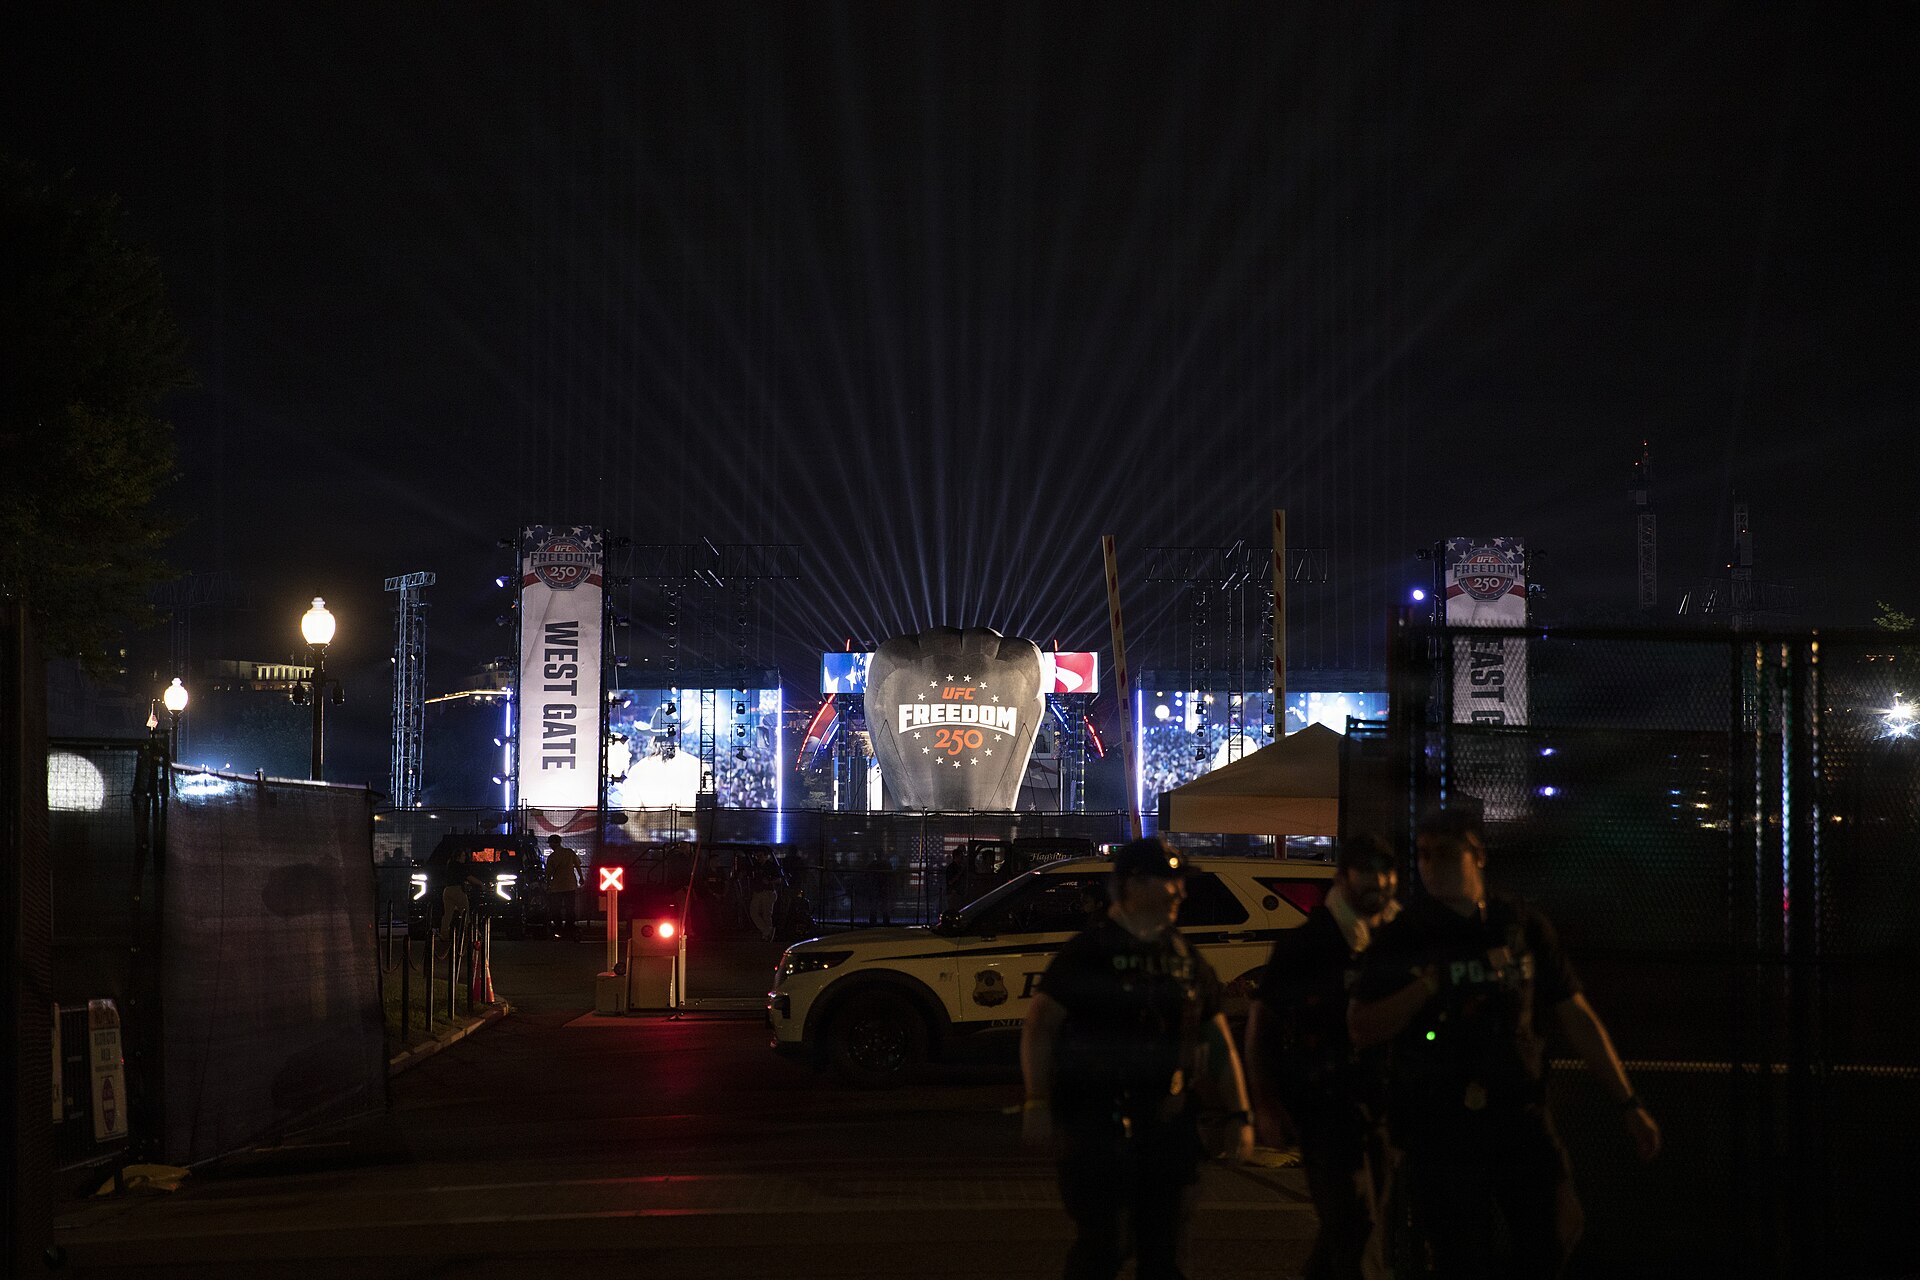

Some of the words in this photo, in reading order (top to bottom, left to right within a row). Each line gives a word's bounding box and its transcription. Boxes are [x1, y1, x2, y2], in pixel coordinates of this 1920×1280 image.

[530, 552, 597, 568] FREEDOM
[550, 566, 576, 580] 250
[1453, 563, 1519, 579] FREEDOM
[1474, 577, 1499, 591] 250
[543, 621, 578, 696] WEST
[1470, 635, 1505, 702] EAST
[942, 687, 976, 700] UFC
[898, 704, 1017, 737] FREEDOM
[542, 704, 577, 769] GATE
[934, 729, 984, 756] 250
[991, 1019, 1023, 1027] UNIT
